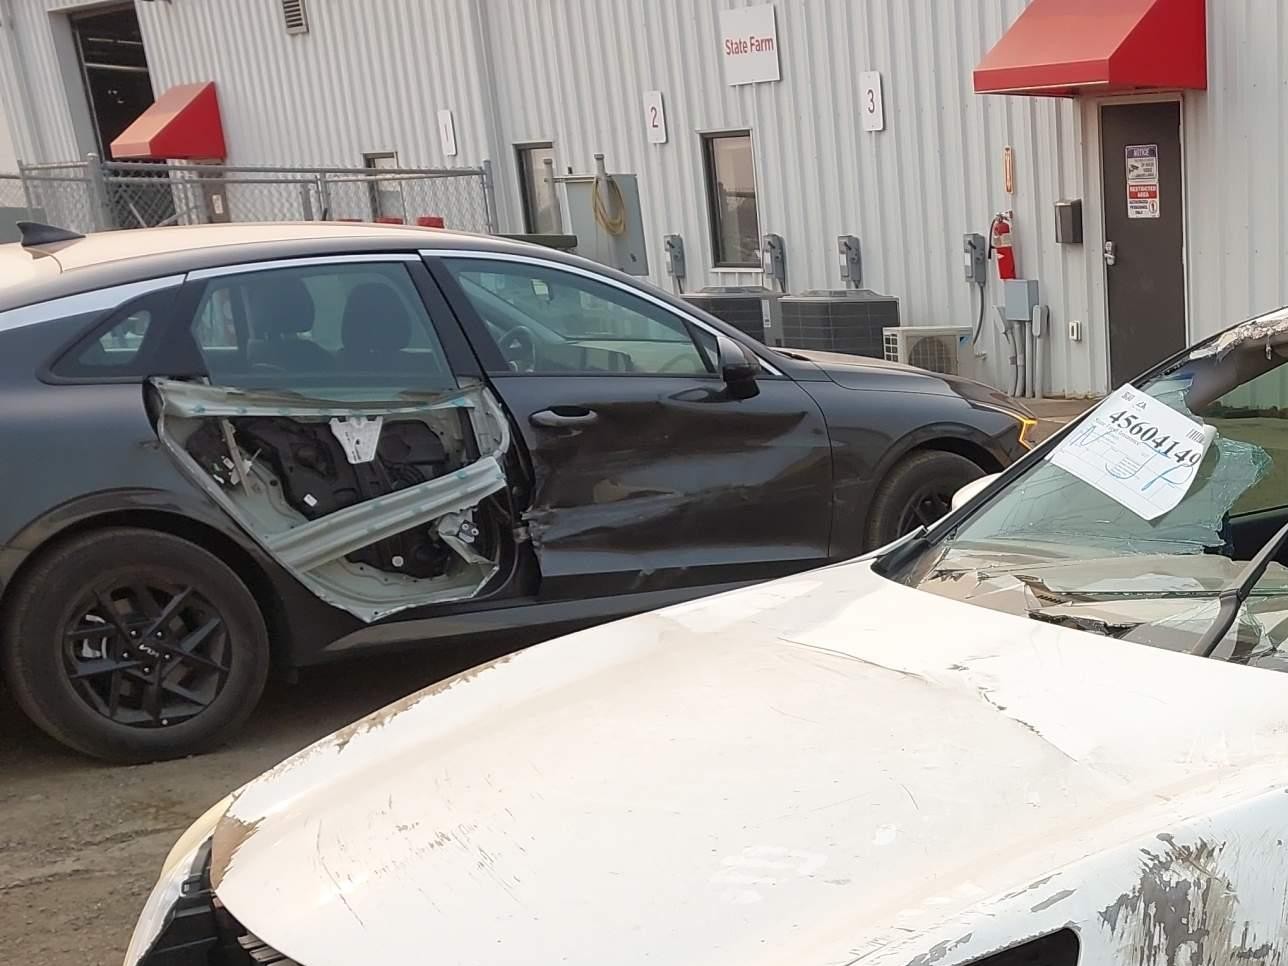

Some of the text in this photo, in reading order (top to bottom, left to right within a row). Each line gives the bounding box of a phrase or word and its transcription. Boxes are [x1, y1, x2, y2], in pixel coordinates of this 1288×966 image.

[725, 36, 774, 55] State Farm
[867, 89, 875, 114] 3
[650, 106, 659, 128] 2
[1109, 410, 1202, 466] 45604149
